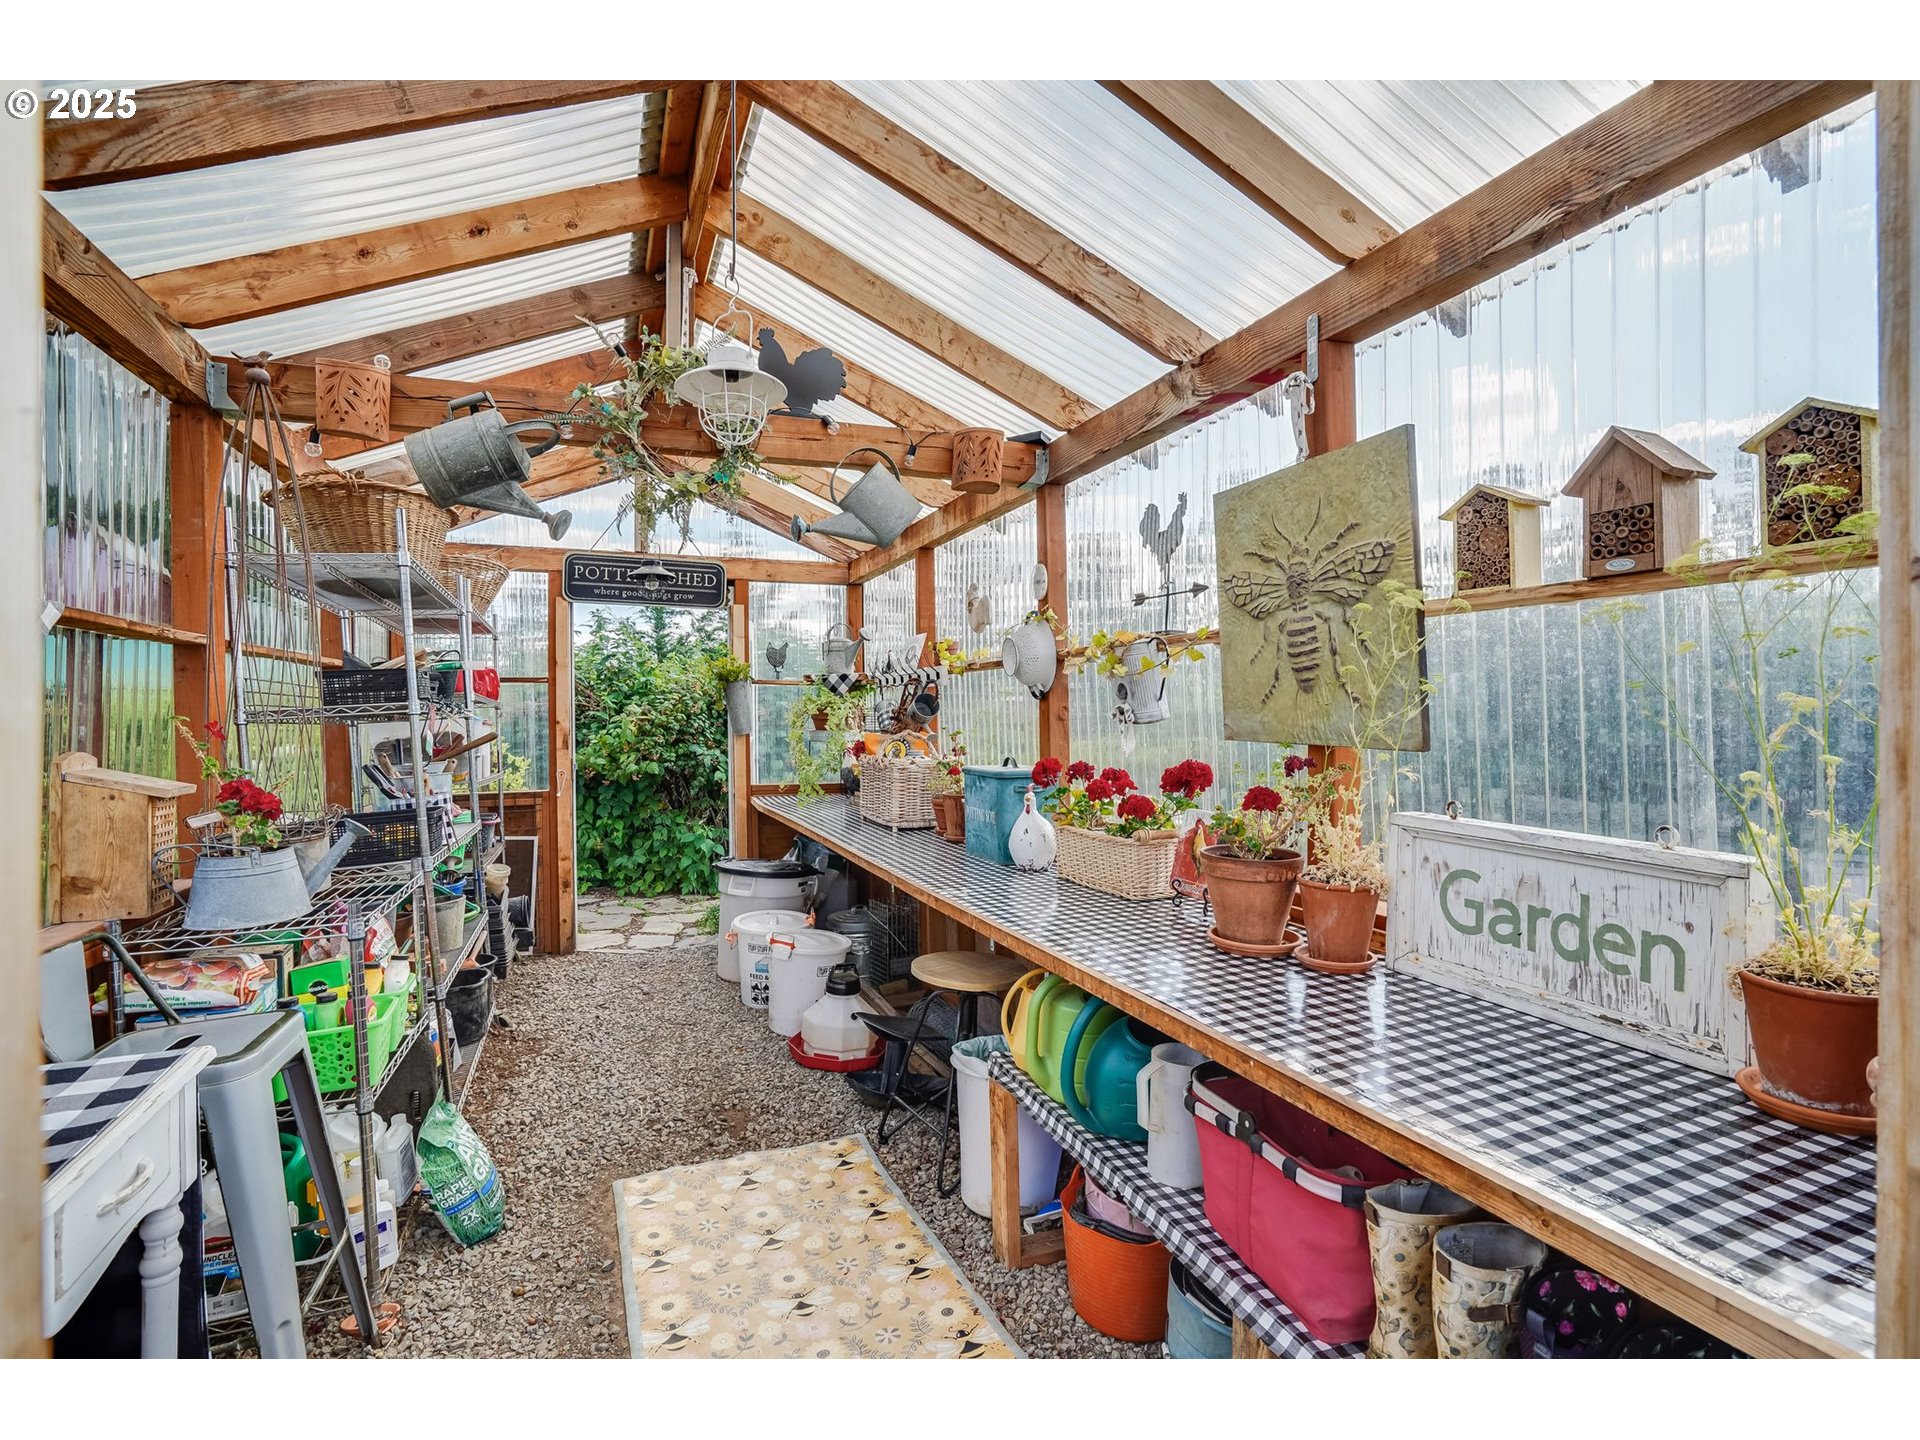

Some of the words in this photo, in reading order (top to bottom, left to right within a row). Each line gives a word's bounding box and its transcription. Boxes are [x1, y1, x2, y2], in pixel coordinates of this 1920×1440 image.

[574, 565, 650, 583] POTTI
[667, 571, 717, 587] SHED
[594, 586, 620, 596] where
[674, 593, 695, 601] grow
[1439, 868, 1686, 992] Garden
[750, 973, 763, 981] FEED
[440, 1183, 475, 1209] GRASS
[460, 1208, 481, 1226] 2X
